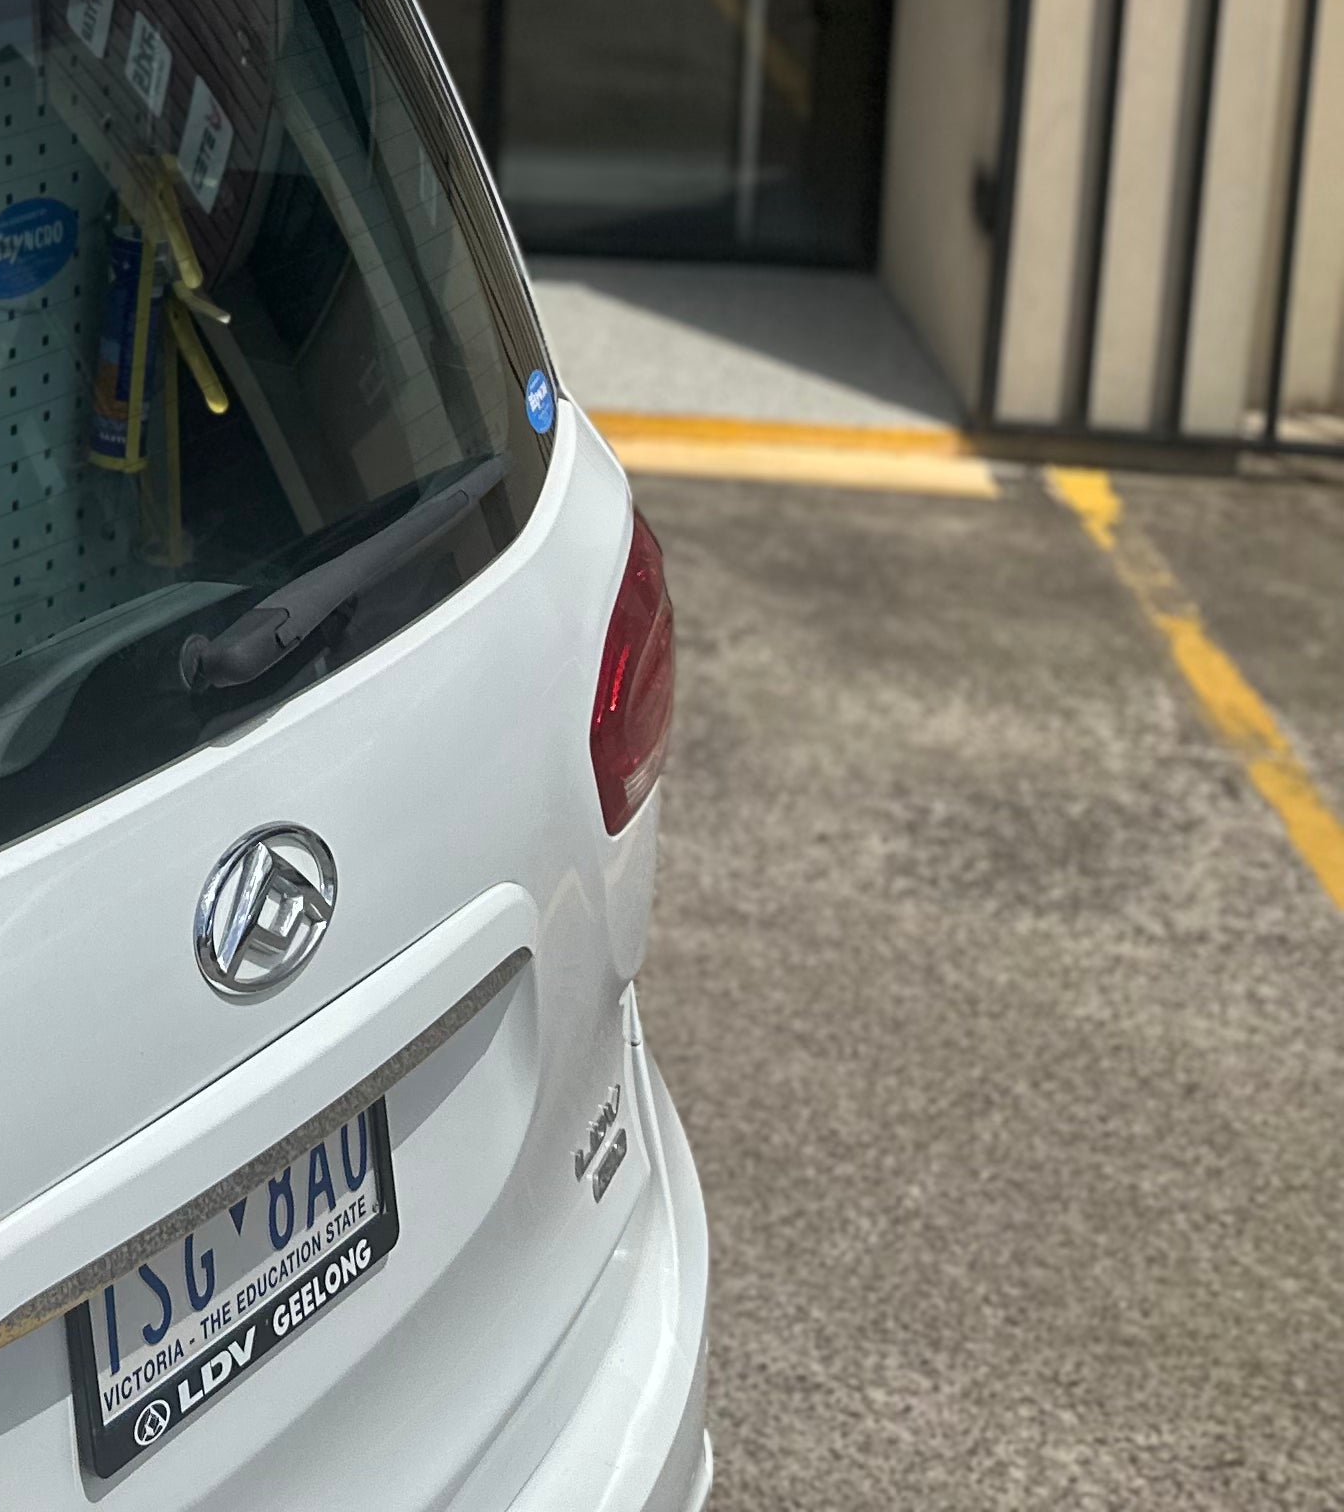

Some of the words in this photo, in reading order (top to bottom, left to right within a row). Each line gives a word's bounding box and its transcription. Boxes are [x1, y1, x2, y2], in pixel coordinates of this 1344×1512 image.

[103, 1338, 184, 1412] VICTORIA
[200, 1299, 231, 1339] THE
[237, 1230, 321, 1315] EDUCATION
[325, 1194, 367, 1243] STATE
[177, 1325, 256, 1413] LDV
[272, 1238, 372, 1337] GEELONG
